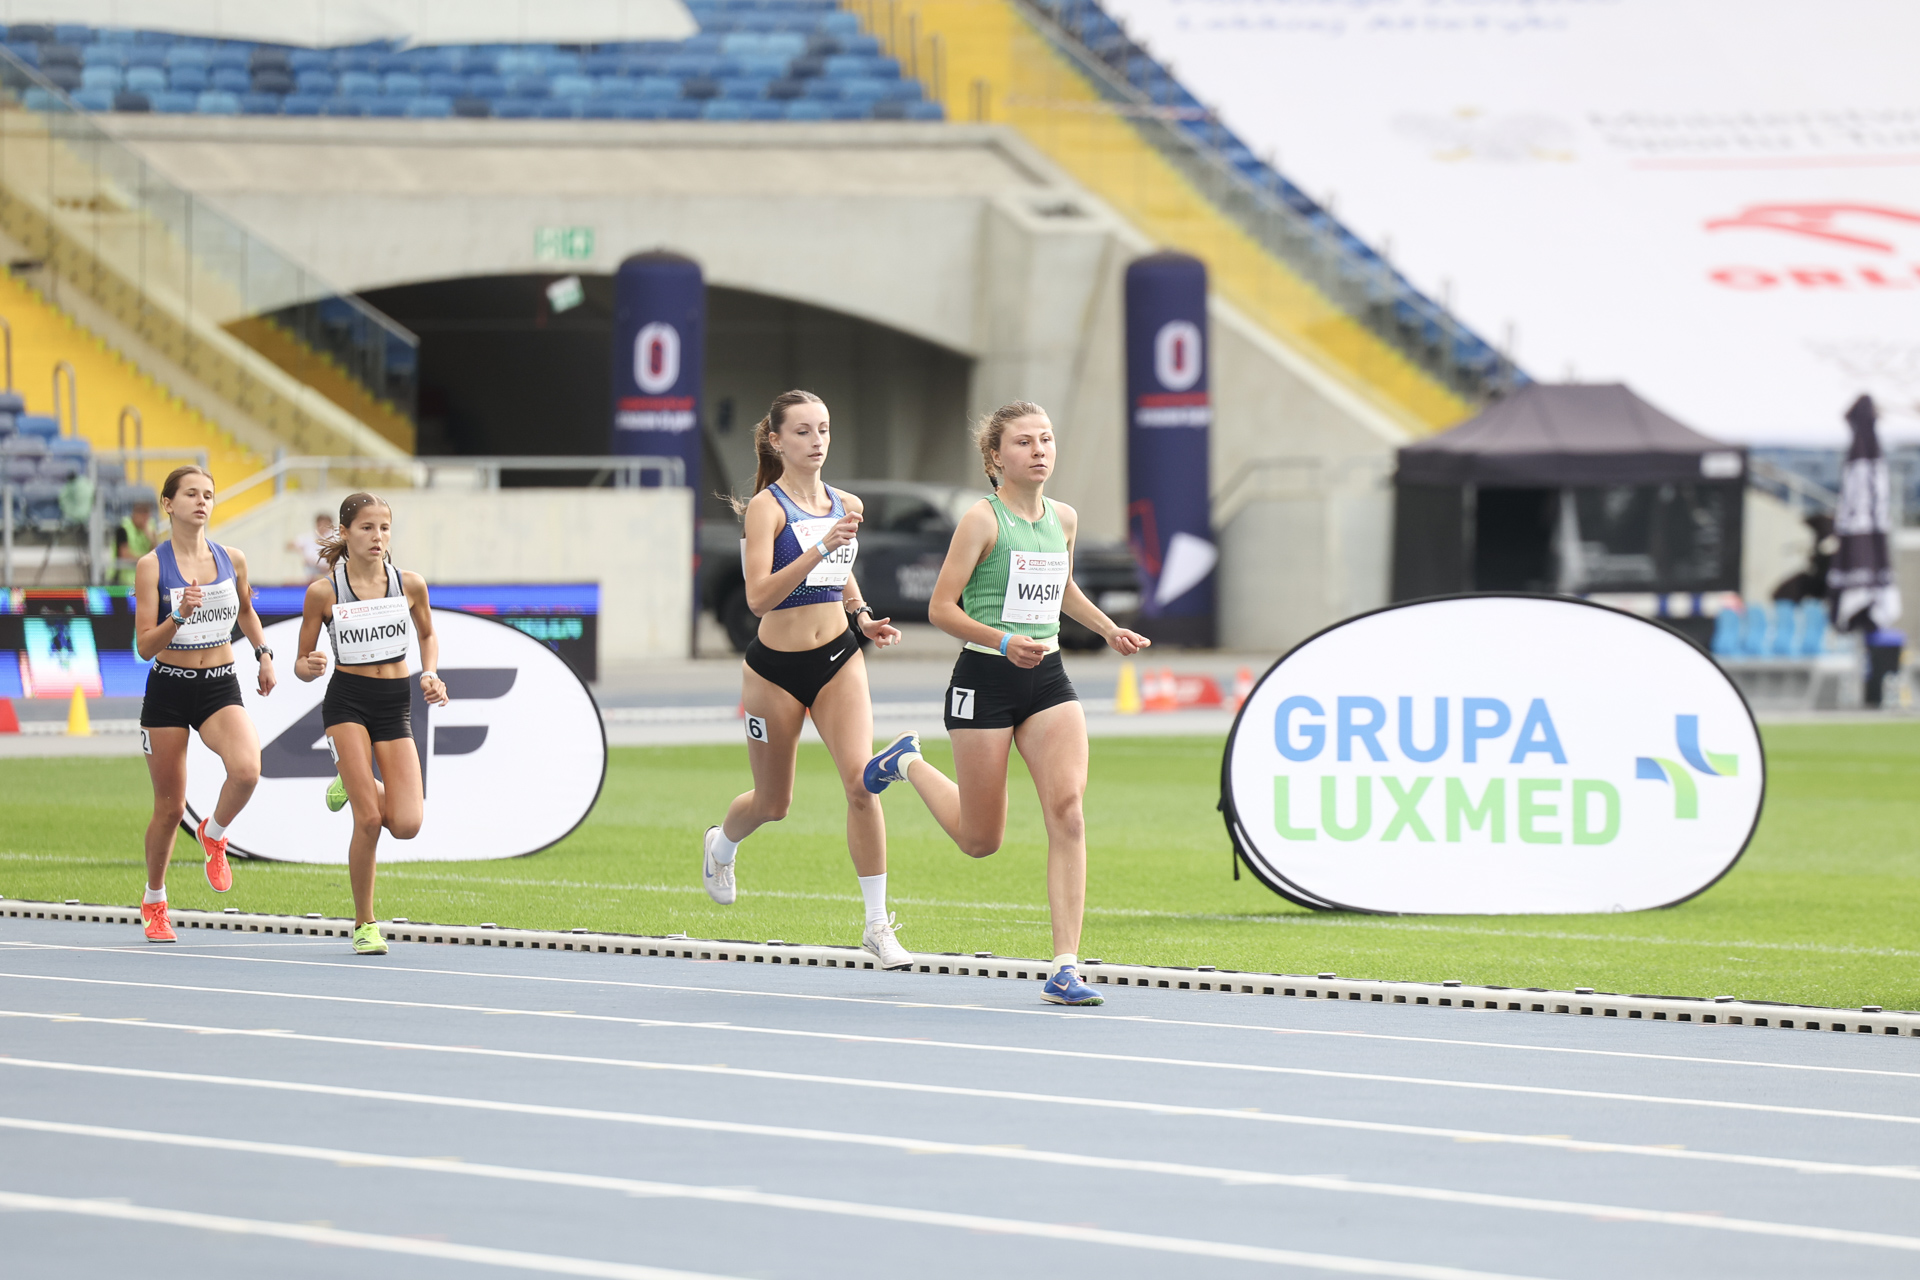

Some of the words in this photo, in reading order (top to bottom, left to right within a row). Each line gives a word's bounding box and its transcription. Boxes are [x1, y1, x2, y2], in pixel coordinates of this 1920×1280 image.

[808, 548, 855, 563] ACHEJ
[340, 619, 406, 645] KWIATOŃ
[159, 665, 198, 679] PRO
[956, 690, 969, 716] 7
[748, 717, 763, 739] 6
[1274, 695, 1568, 764] GRUPA
[140, 730, 149, 752] 2
[1273, 774, 1621, 846] LUXMED
